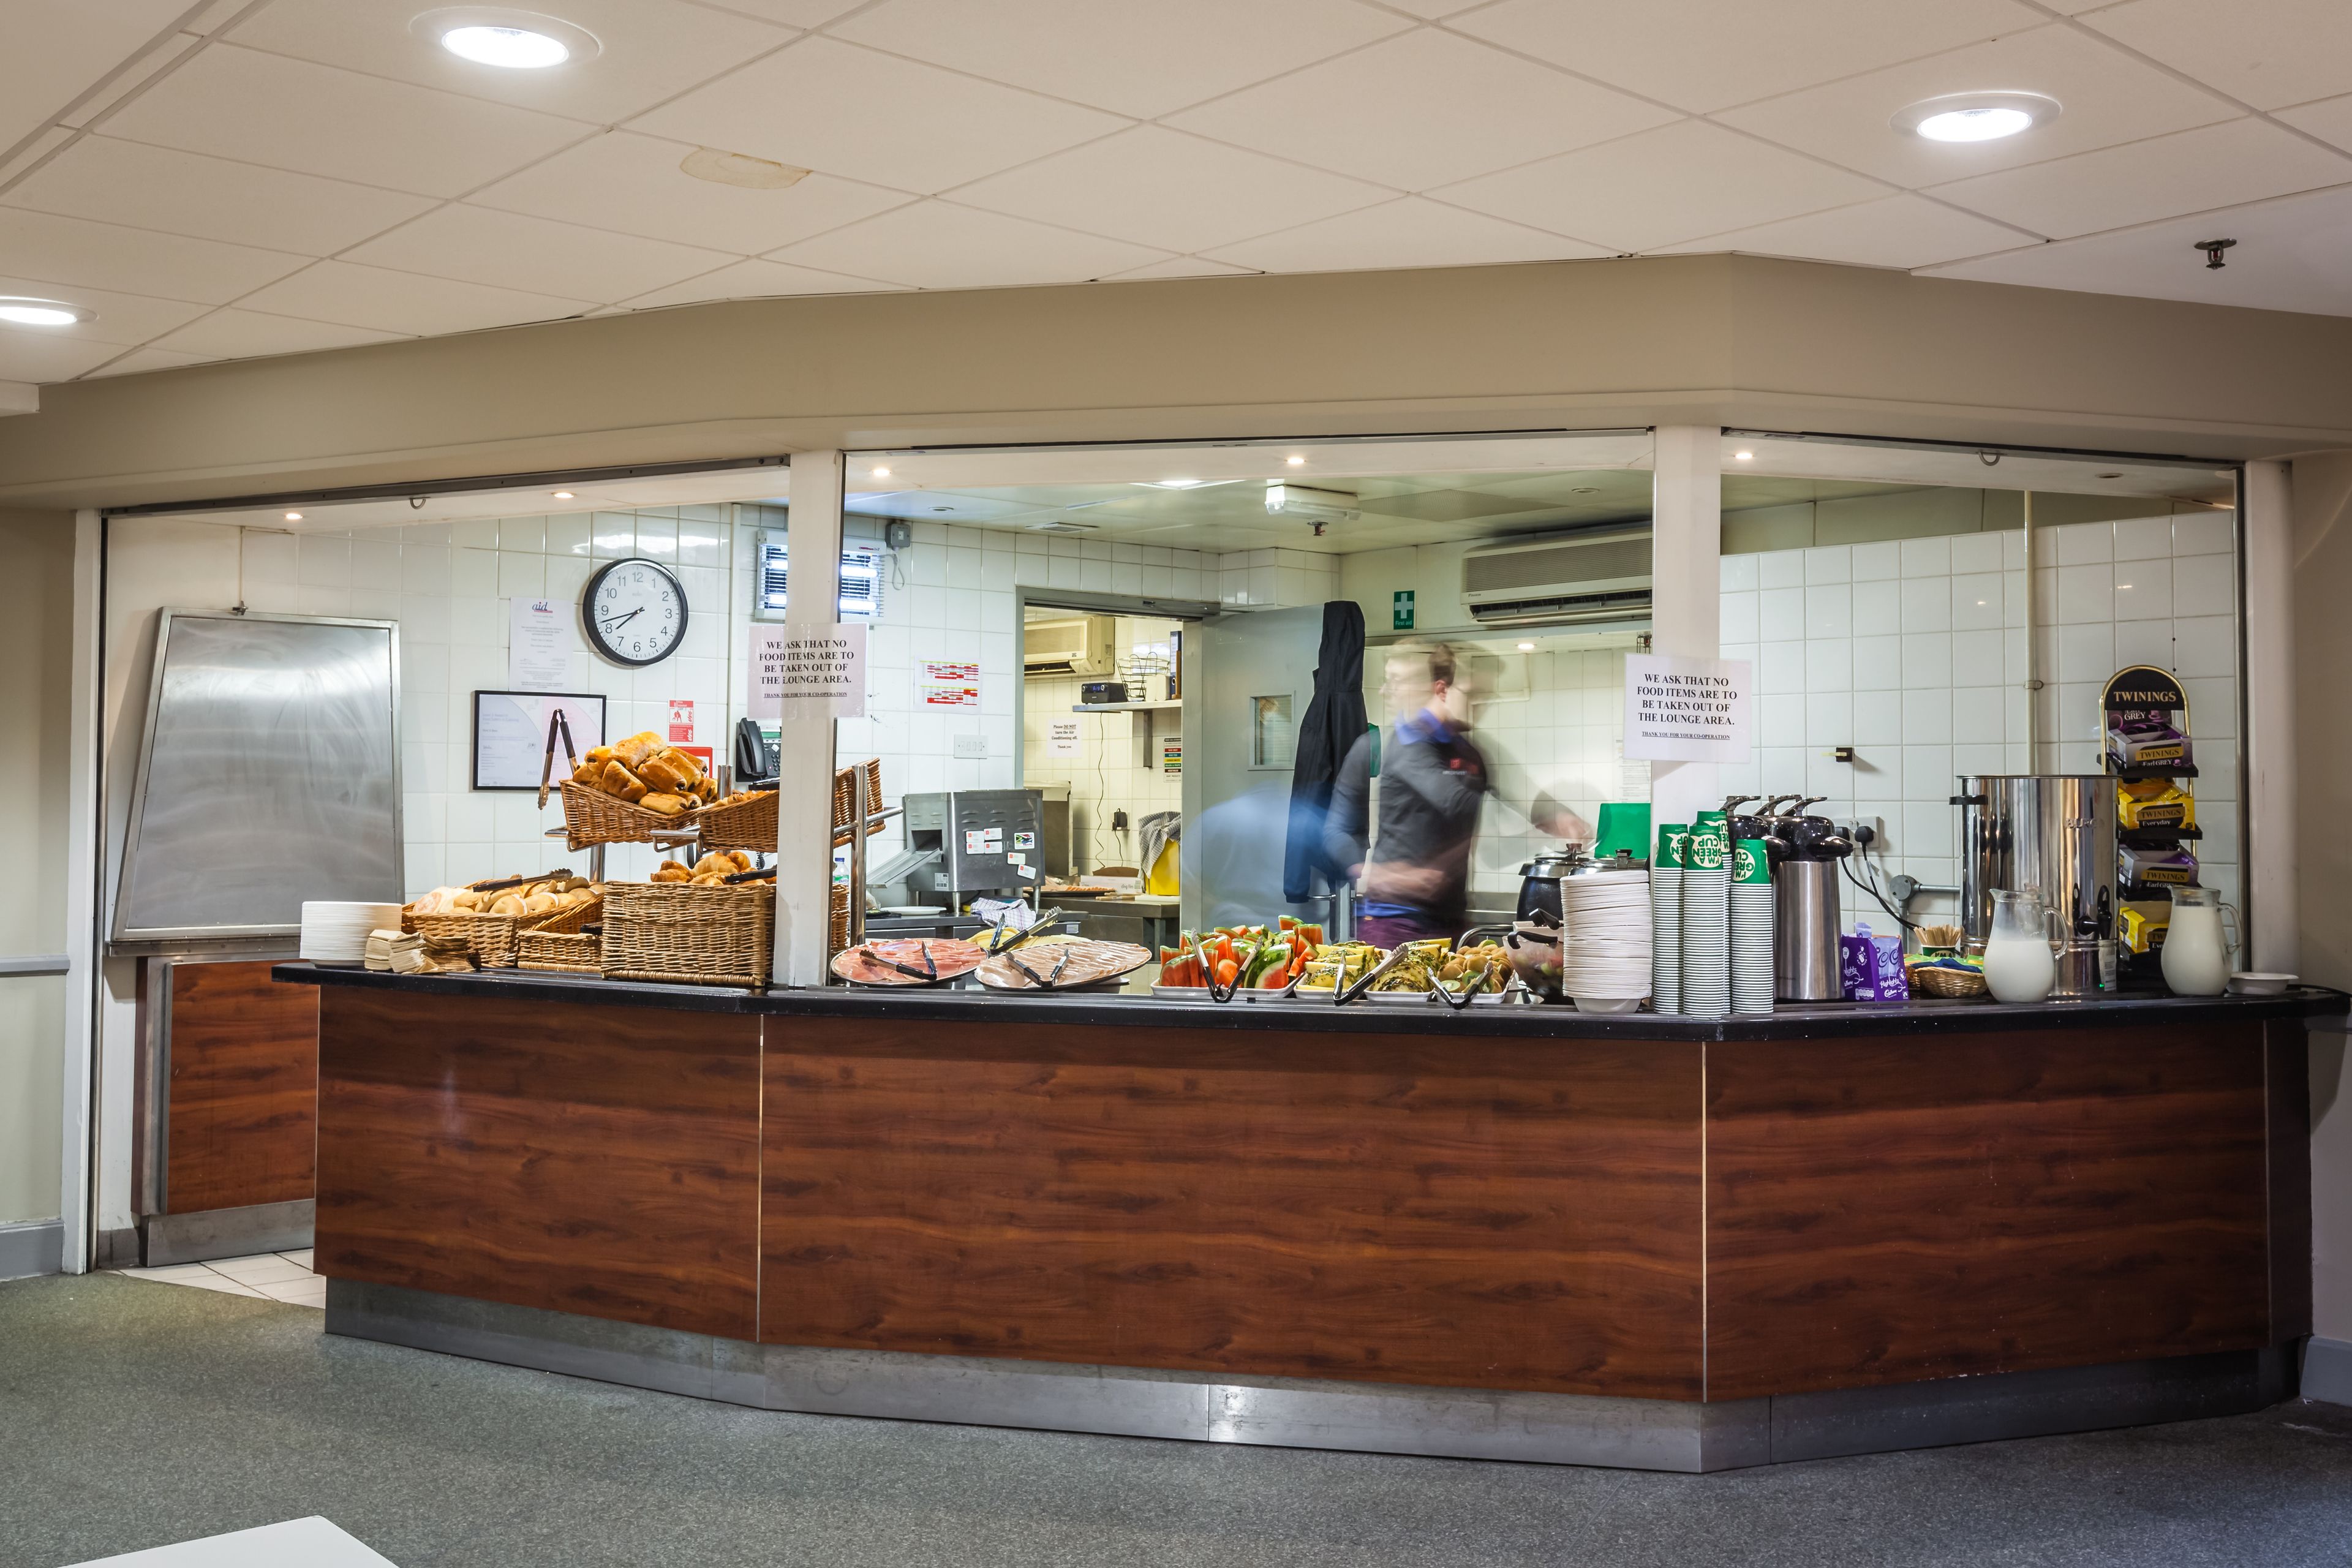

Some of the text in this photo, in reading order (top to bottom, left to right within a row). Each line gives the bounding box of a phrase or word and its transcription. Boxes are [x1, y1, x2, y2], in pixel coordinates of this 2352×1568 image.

[617, 576, 626, 586] 11
[632, 571, 643, 582] 12
[652, 578, 656, 588] 1
[605, 588, 617, 598] 10
[662, 591, 669, 601] 2
[532, 601, 548, 611] aid
[601, 605, 609, 616] 9
[665, 608, 673, 619] 3
[605, 623, 612, 634] 8
[661, 626, 668, 636] 4
[617, 636, 624, 646] 7
[649, 638, 657, 648] 5
[785, 641, 801, 649] ASK
[832, 639, 847, 648] NO
[633, 641, 641, 652] 6
[788, 652, 815, 661] ITEMS
[779, 663, 809, 673] TAKEN
[783, 676, 820, 684] LOUNGE
[822, 675, 851, 684] AREA.
[1645, 674, 1728, 687] WE ASK THAT NO
[1637, 686, 1737, 699] FOOD ITEMS ARE TO
[2113, 691, 2176, 702] TWININGS
[1642, 699, 1730, 712] BE TAKEN OUT OF
[1638, 712, 1735, 725] THE LOUNGE AREA.
[2124, 712, 2146, 720] GREY
[2140, 749, 2179, 759] TWININGS
[2141, 809, 2181, 818] TWININGS
[1677, 835, 1688, 845] UP
[1698, 838, 1719, 847] CUP
[1692, 848, 1722, 858] GREEN
[1736, 852, 1749, 861] CU
[1735, 861, 1754, 872] GRE
[2146, 872, 2185, 881] TWININGS
